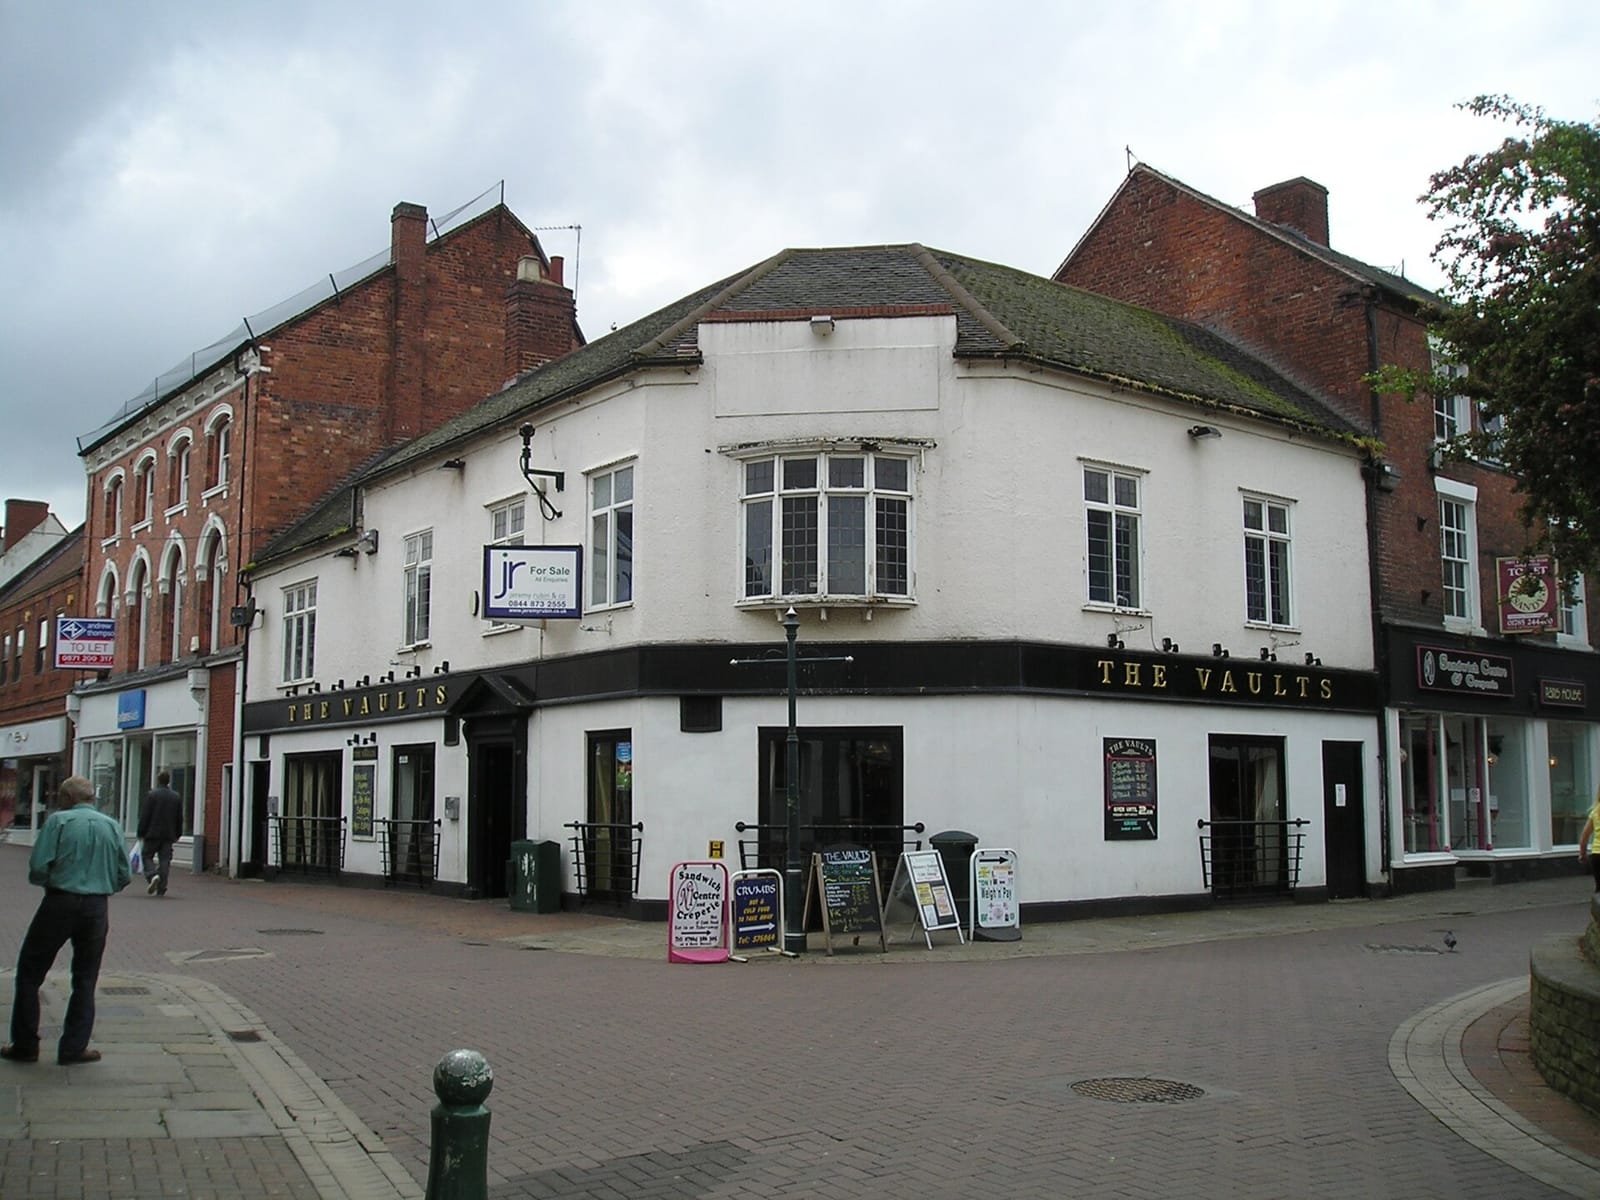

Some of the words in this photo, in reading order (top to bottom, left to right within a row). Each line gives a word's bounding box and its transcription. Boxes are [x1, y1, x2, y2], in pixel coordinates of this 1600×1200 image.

[530, 566, 546, 575] For
[549, 566, 570, 576] Sale
[70, 642, 85, 652] TO
[88, 642, 108, 652] LET
[1098, 660, 1167, 687] THE
[1195, 667, 1332, 699] VAULTS
[288, 701, 328, 722] THE
[343, 685, 447, 716] VAULTS
[1109, 741, 1123, 754] THE
[1124, 740, 1153, 756] VAULTS
[824, 852, 840, 861] THE
[841, 850, 871, 861] VAULTS
[678, 871, 721, 892] Sandwich
[692, 891, 720, 900] Centre
[736, 884, 776, 896] CRUMBS
[676, 901, 720, 920] Creperie
